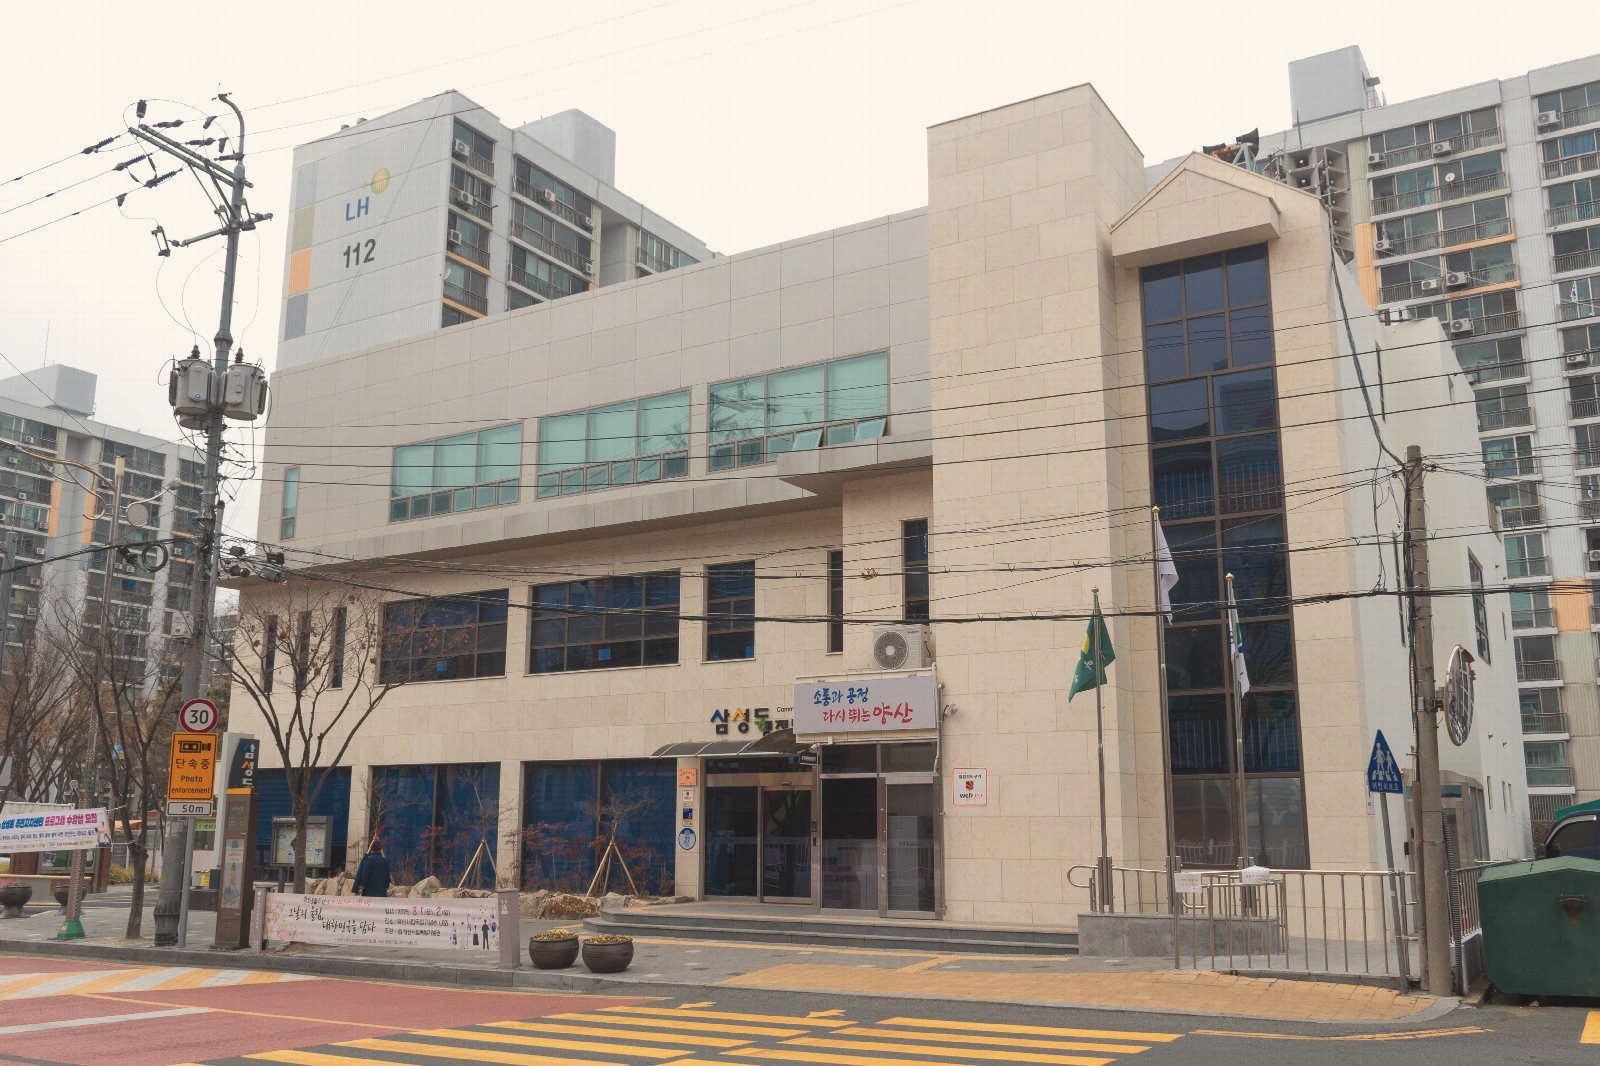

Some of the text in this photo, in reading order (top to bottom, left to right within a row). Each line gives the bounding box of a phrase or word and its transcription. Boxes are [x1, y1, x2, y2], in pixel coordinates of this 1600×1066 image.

[345, 196, 369, 221] LH
[343, 238, 376, 268] 112
[813, 686, 869, 707] 소통과 공정
[189, 709, 209, 724] 30
[822, 701, 914, 726] 다시 뛰는 양산
[175, 758, 210, 770] 단속중
[180, 775, 203, 783] Photo
[171, 786, 211, 794] enforcement
[182, 804, 204, 813] 50m
[288, 905, 308, 920] 그날의
[322, 919, 377, 935] 대한민국을 담다
